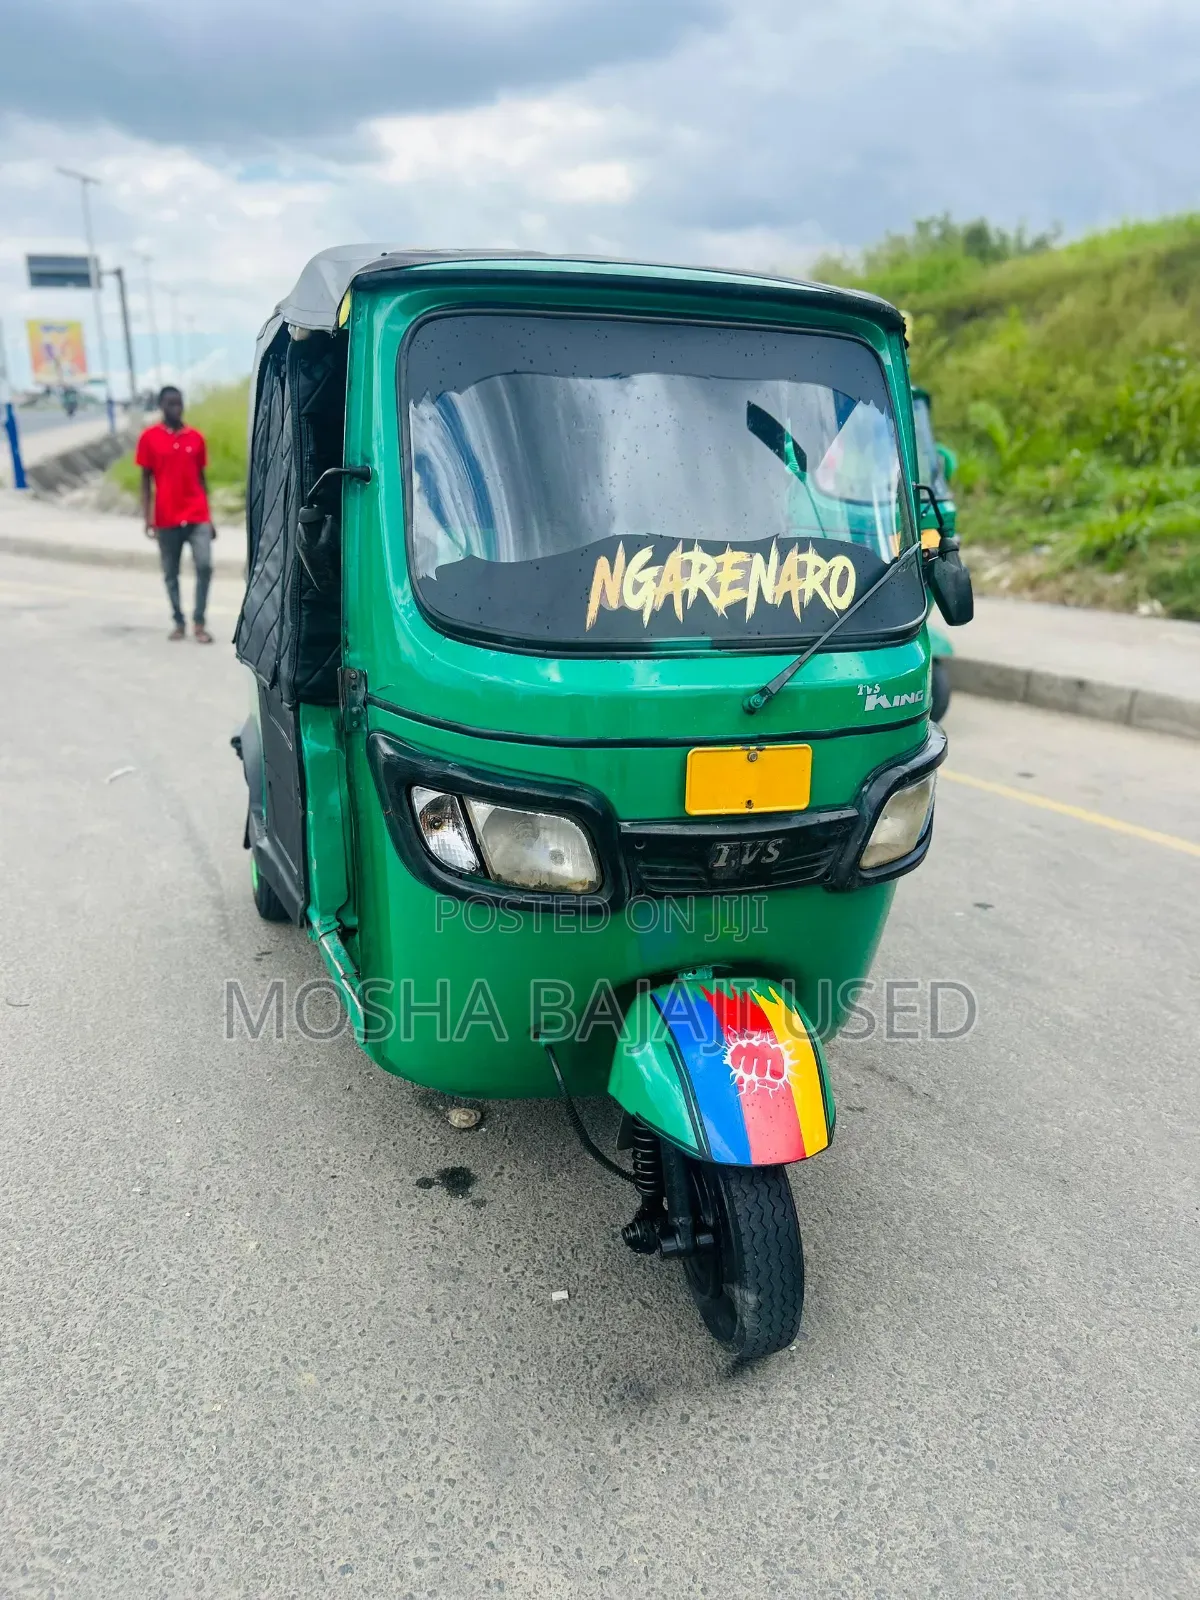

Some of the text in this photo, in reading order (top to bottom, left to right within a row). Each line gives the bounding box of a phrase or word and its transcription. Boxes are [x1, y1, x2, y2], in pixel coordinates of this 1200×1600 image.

[585, 539, 856, 632] NGARENARO
[864, 689, 924, 712] KING
[709, 838, 784, 869] TVS
